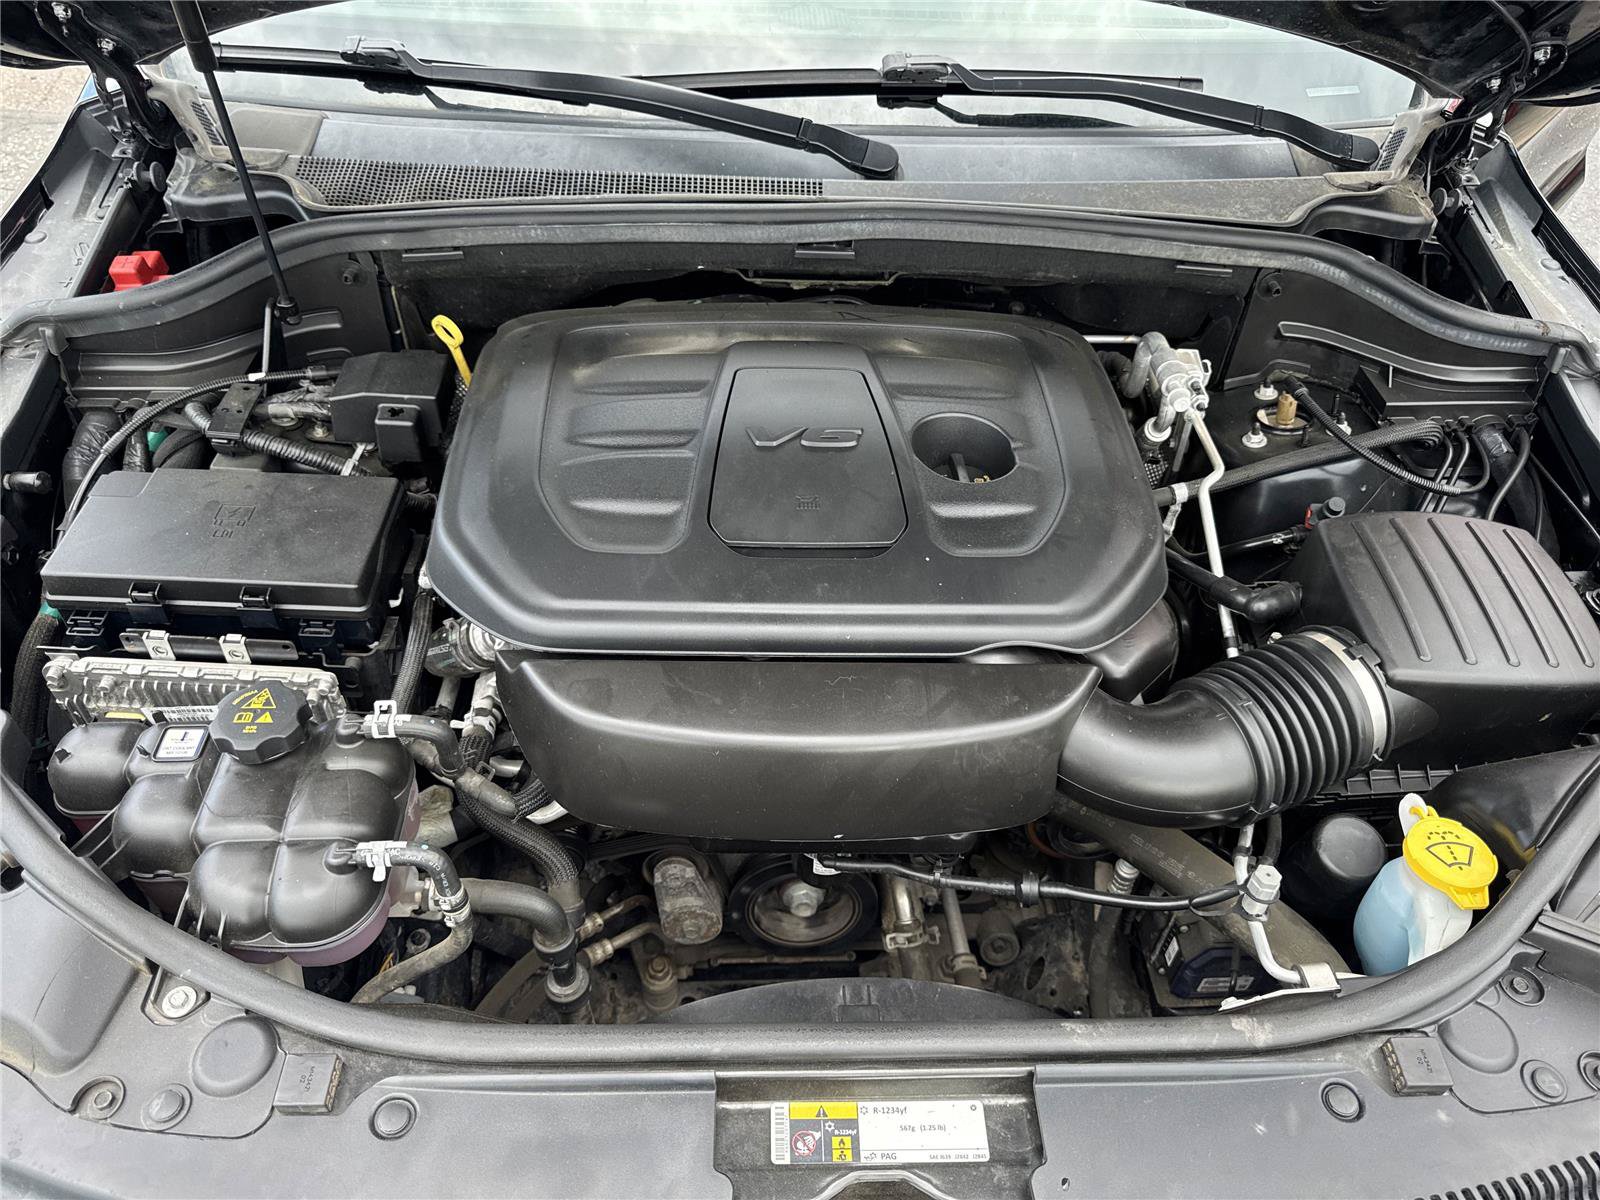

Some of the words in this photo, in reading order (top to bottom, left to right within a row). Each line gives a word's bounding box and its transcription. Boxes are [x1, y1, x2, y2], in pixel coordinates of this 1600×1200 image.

[745, 426, 863, 448] V6
[873, 1106, 907, 1115] R-1234yf
[899, 1124, 916, 1132] 567g
[920, 1123, 937, 1132] (1.25
